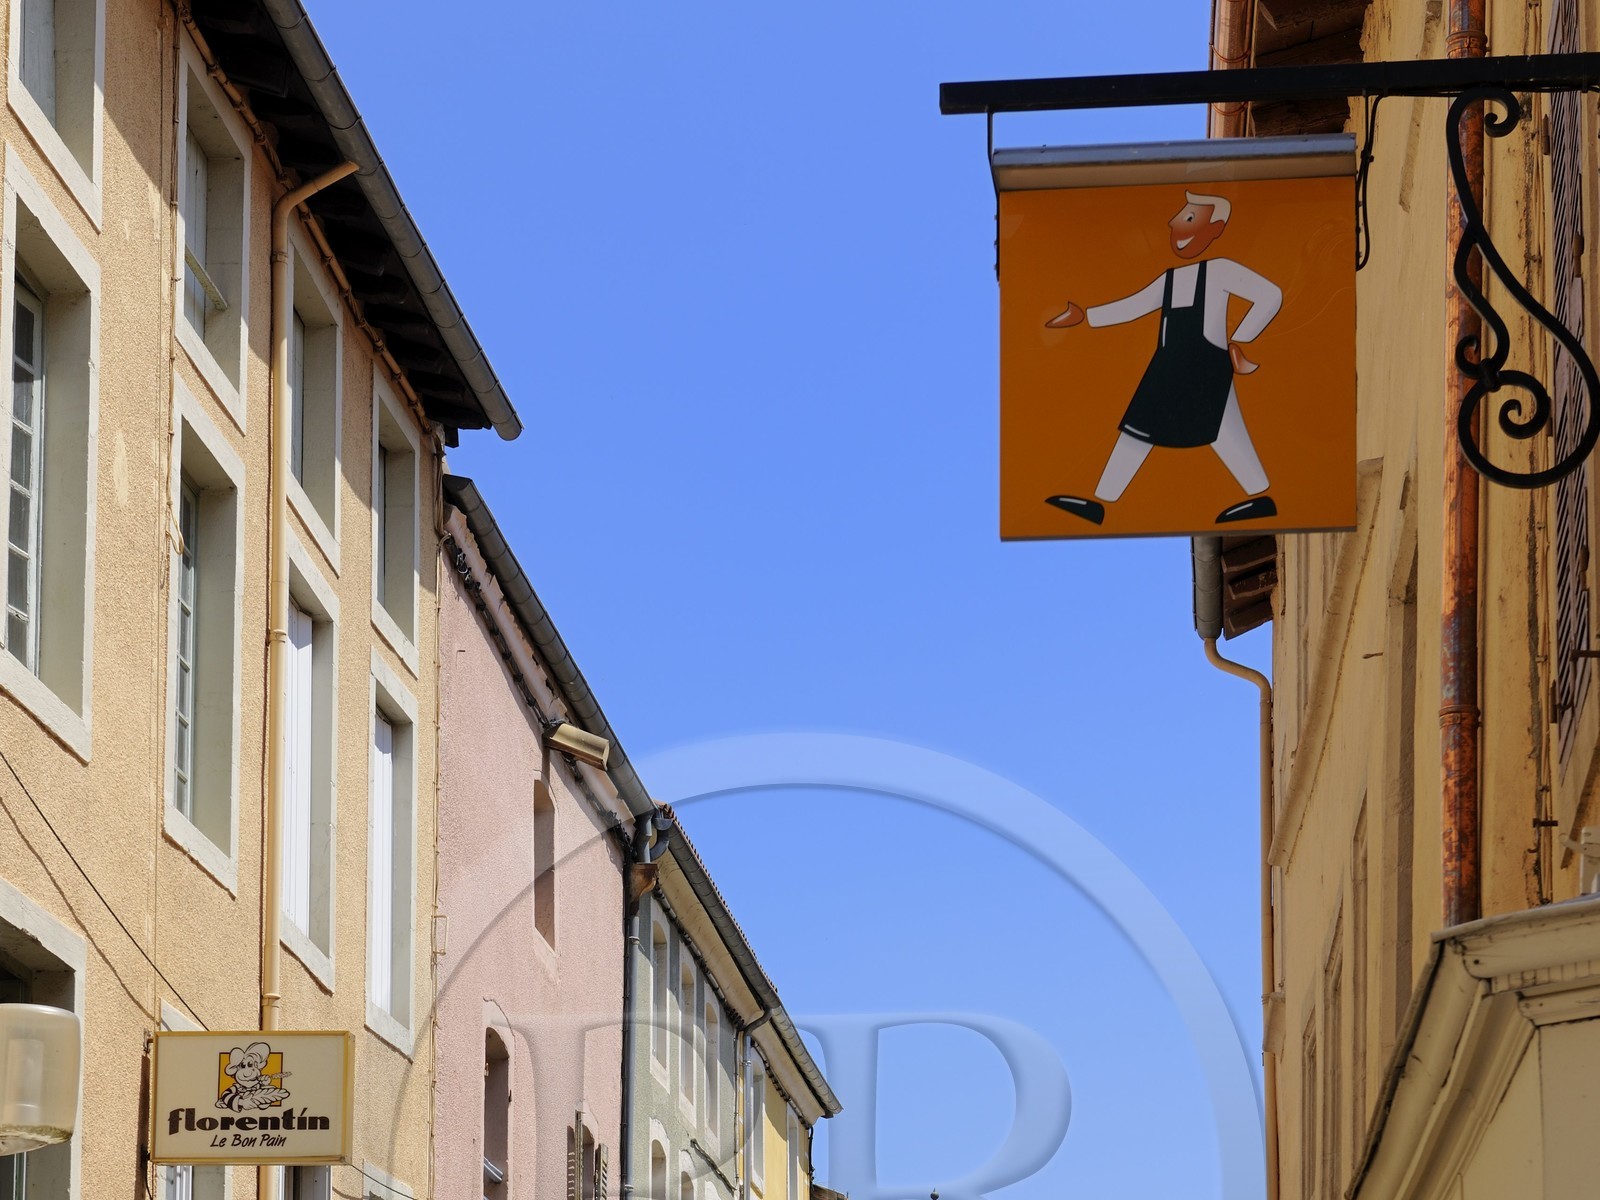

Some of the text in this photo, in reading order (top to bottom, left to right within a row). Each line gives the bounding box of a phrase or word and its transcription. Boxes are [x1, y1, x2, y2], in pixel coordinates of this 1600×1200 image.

[168, 1107, 330, 1136] florentín
[210, 1133, 287, 1148] Le Bon Pain
